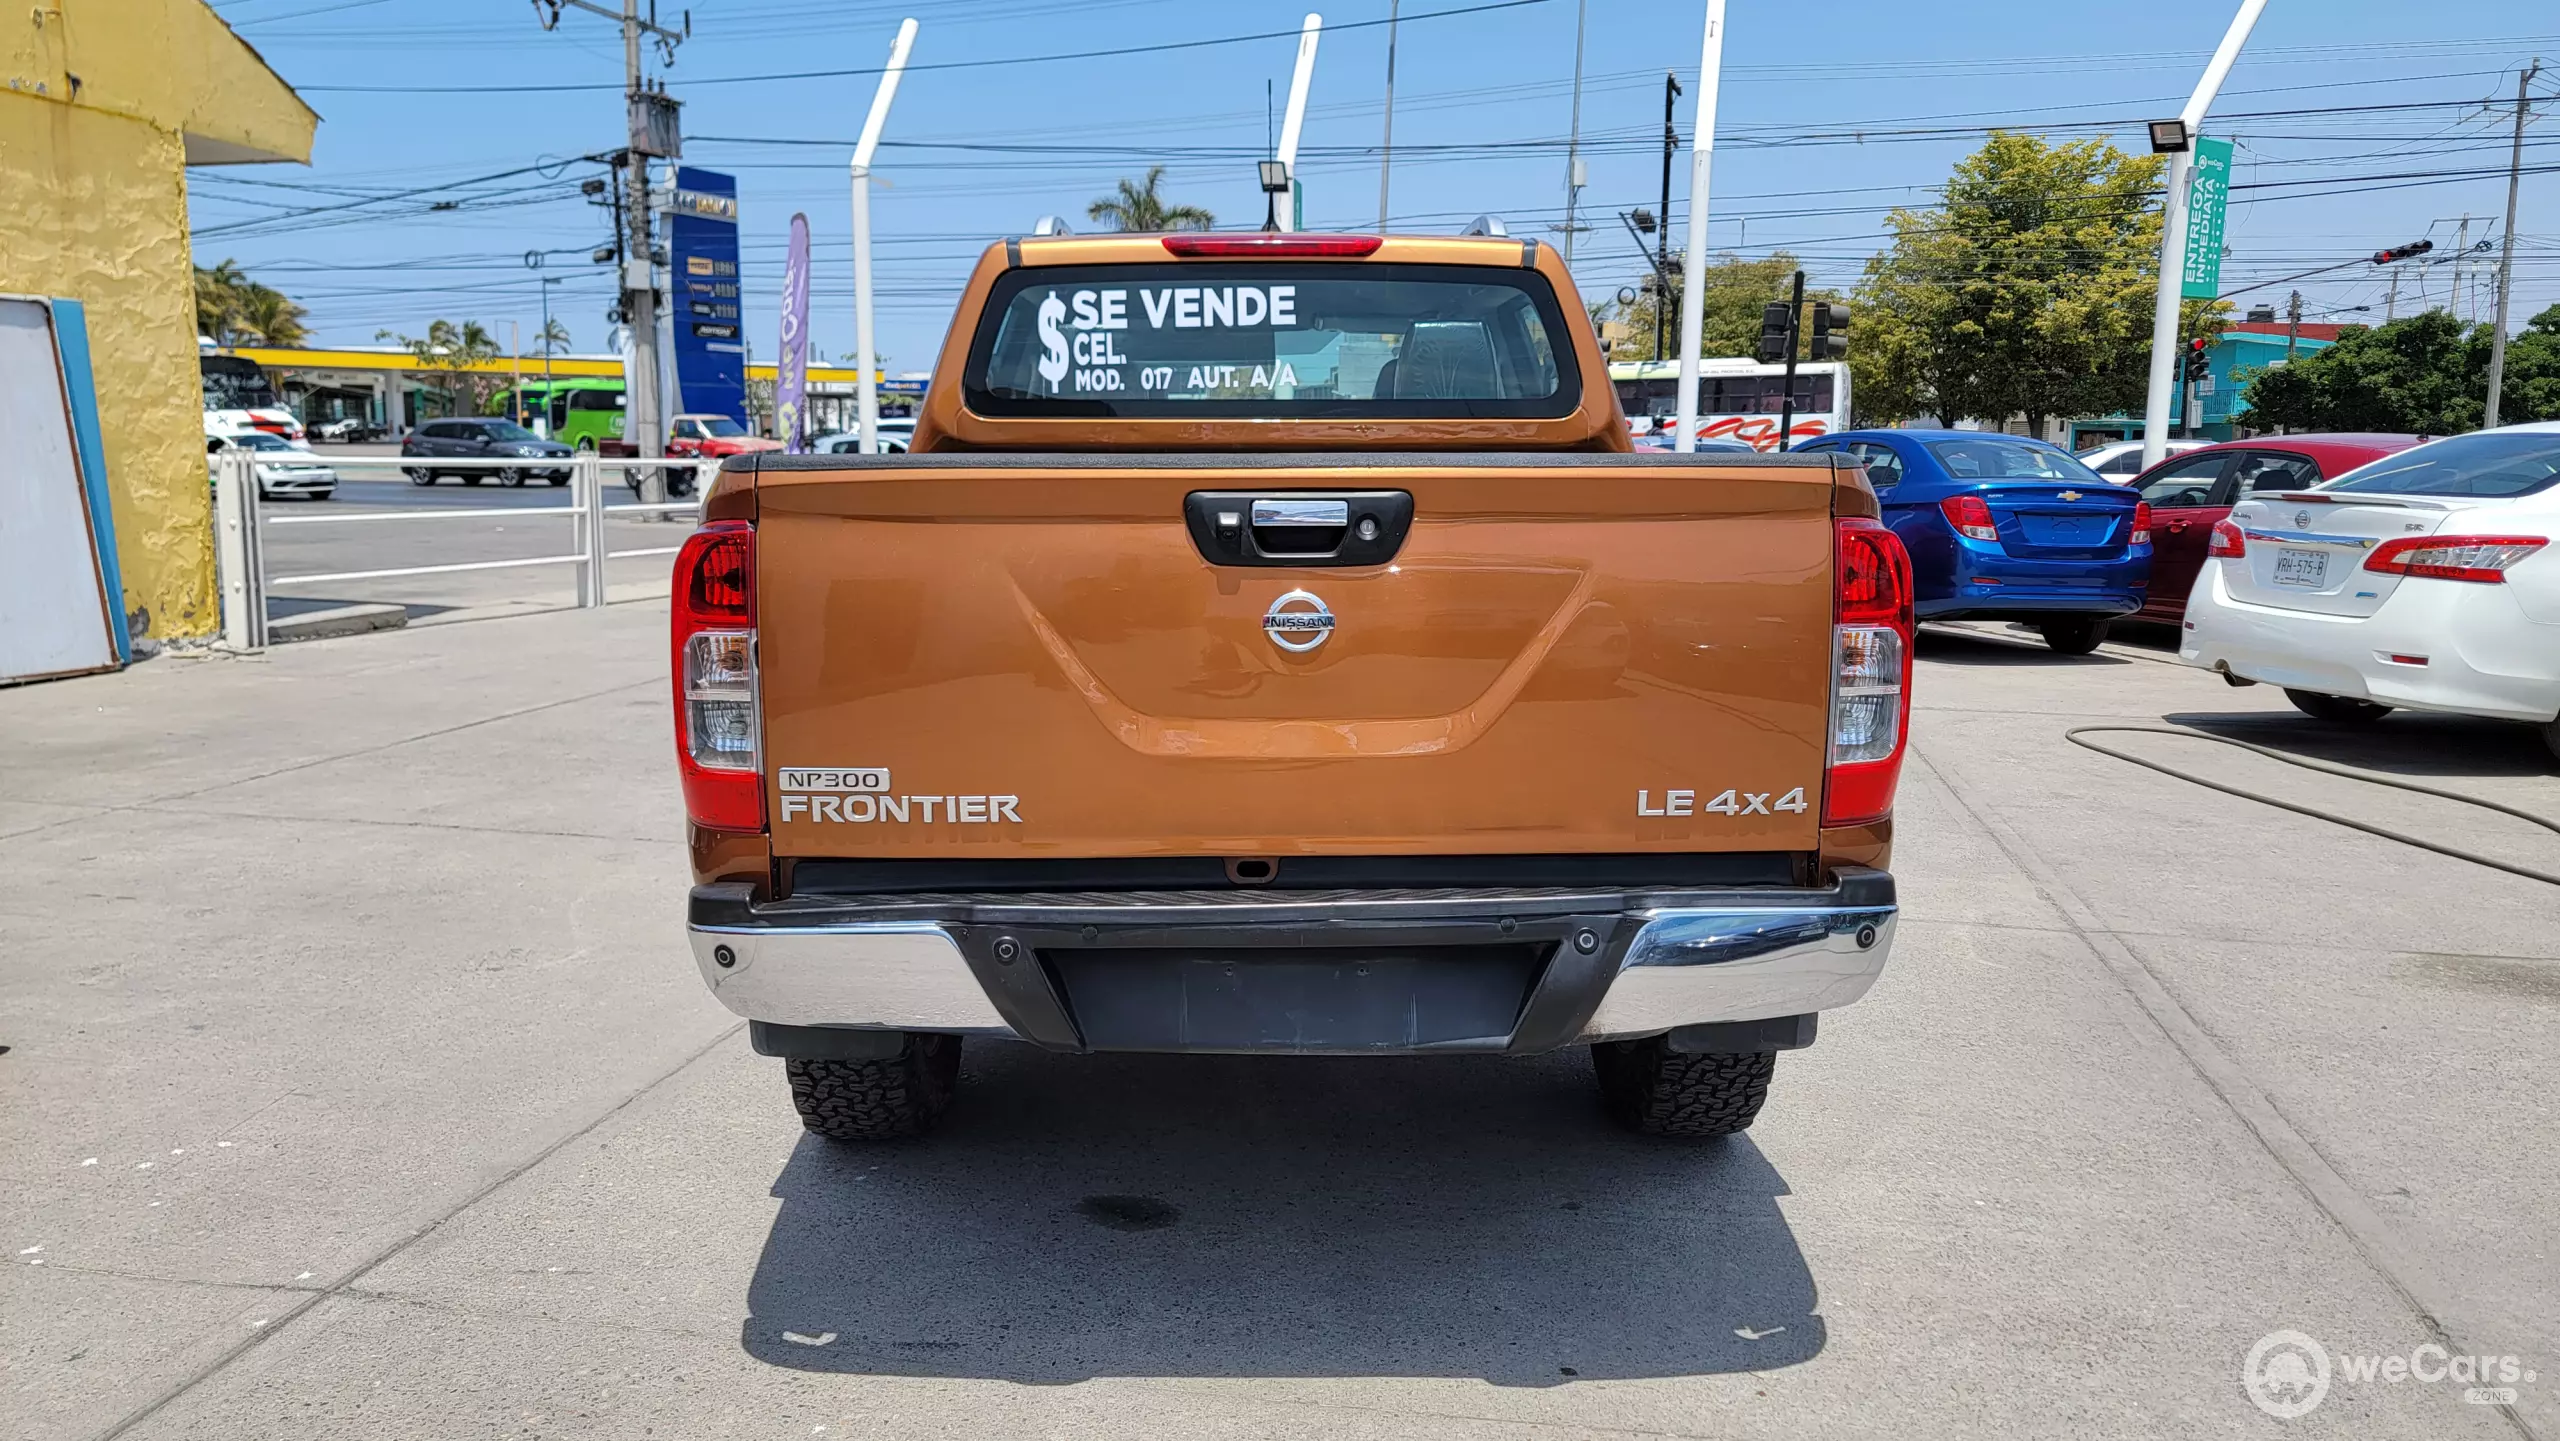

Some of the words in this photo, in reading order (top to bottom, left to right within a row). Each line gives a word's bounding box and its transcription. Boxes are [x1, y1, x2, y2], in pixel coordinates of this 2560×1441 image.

[2185, 176, 2205, 282] ENTREGA
[2195, 178, 2215, 283] INMEDIATA
[1072, 290, 1128, 330] SE
[1140, 285, 1297, 329] VENDE
[1073, 332, 1128, 366] CEL.
[1075, 368, 1125, 391] MOD.
[1140, 367, 1173, 390] 017
[1187, 365, 1239, 389] AUT.
[1250, 359, 1298, 390] A/A
[2277, 557, 2324, 577] VRH-575-B
[1270, 617, 1328, 628] NISSAN
[788, 773, 880, 788] NP300
[780, 794, 1023, 823] FRONTIER
[1637, 789, 1695, 816] LE
[1705, 787, 1808, 816] 4x4
